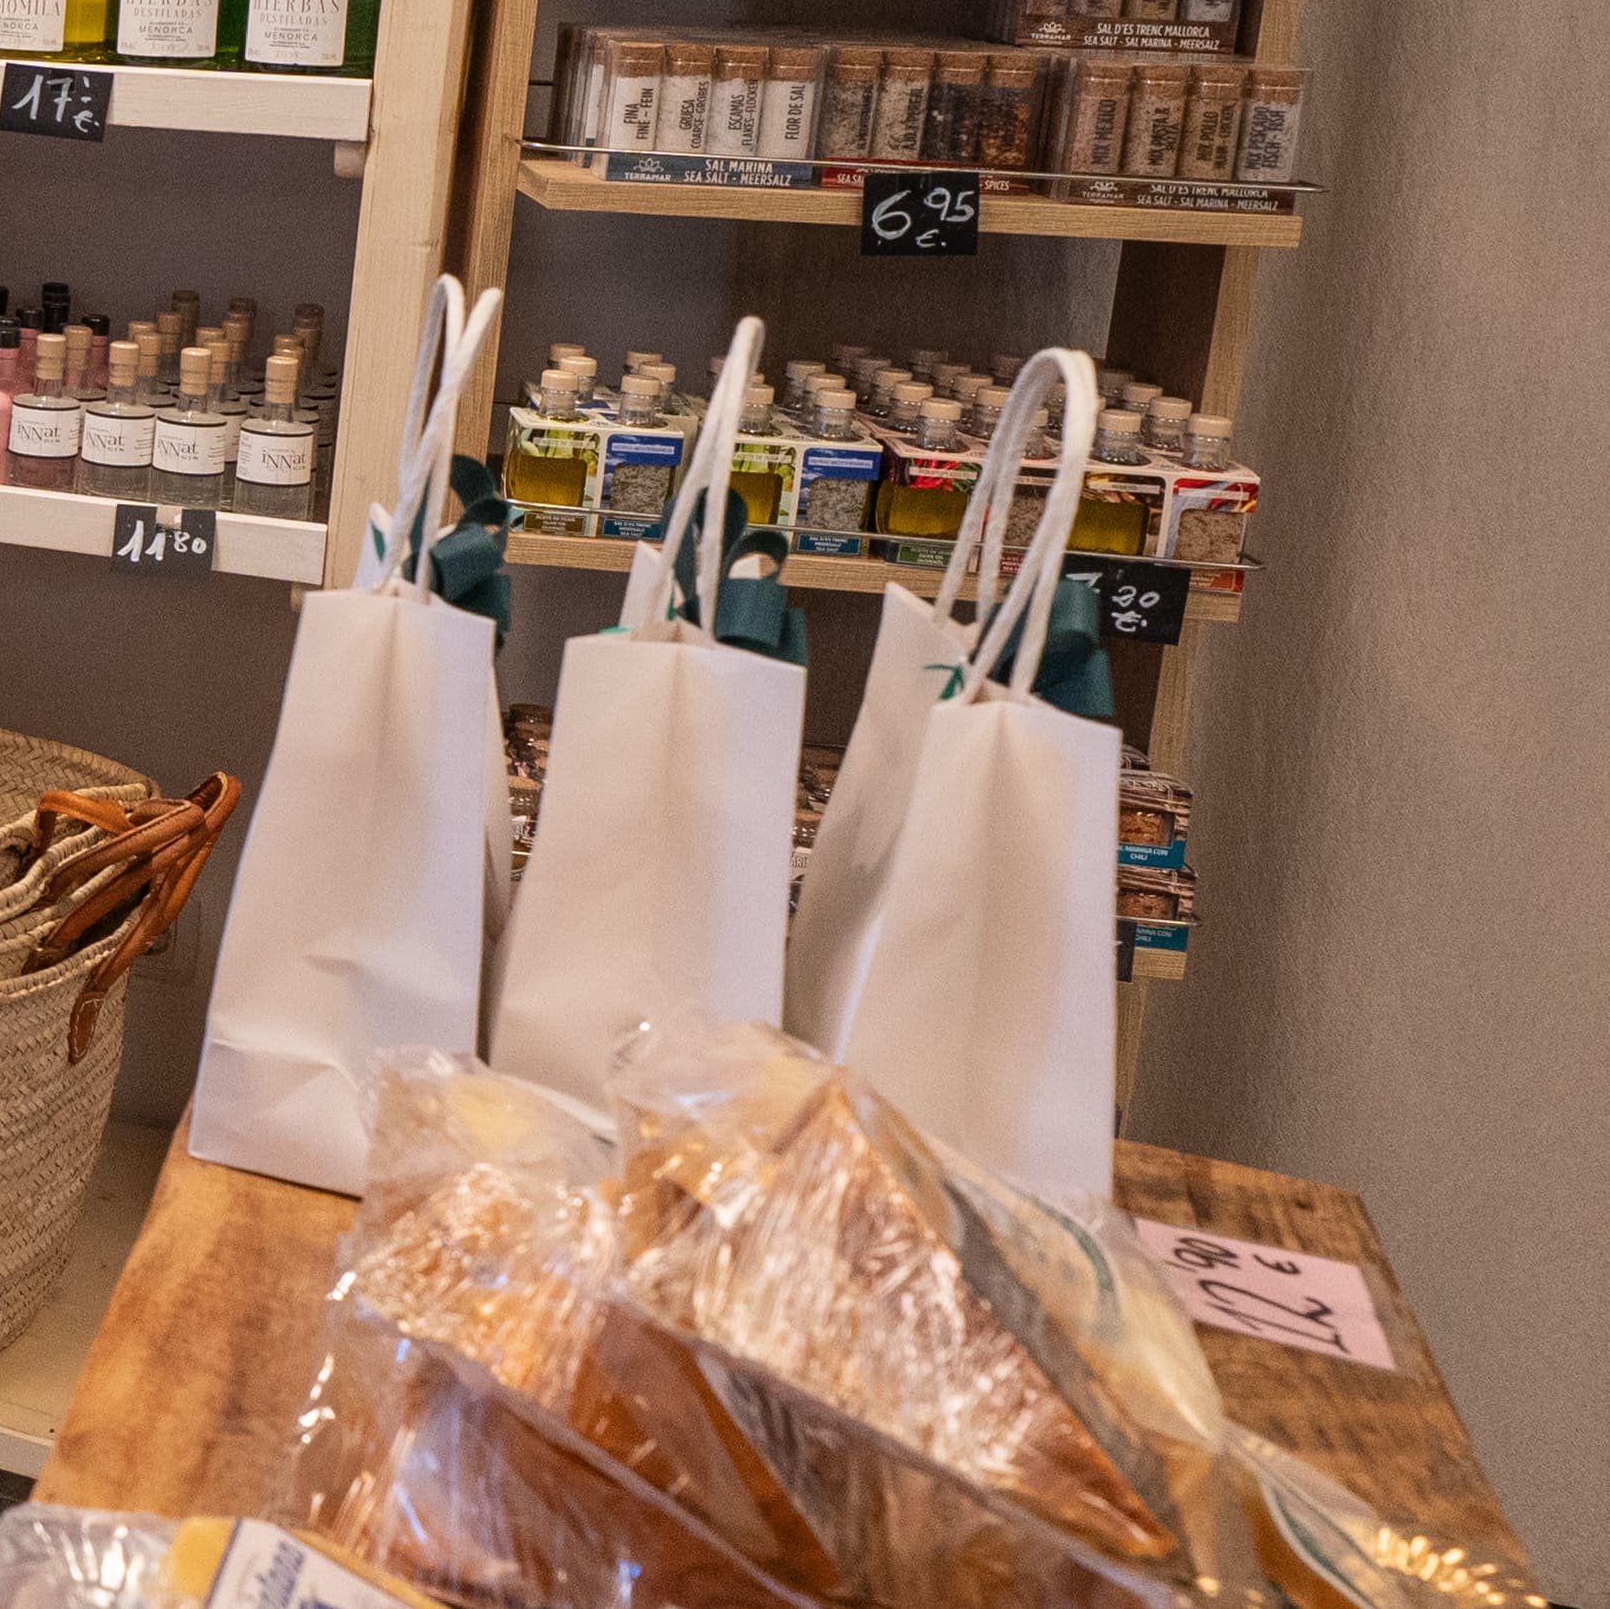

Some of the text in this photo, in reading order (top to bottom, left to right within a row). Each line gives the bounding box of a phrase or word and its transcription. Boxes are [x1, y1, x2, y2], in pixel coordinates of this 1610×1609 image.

[138, 23, 194, 35] MENORCA
[1096, 22, 1113, 34] SAL
[1165, 24, 1210, 38] MALLORCA
[784, 100, 802, 140] FLOR DE
[636, 119, 650, 140] FINE
[728, 160, 773, 174] MARINA
[683, 172, 792, 187] SEA SALT MEERSALZ
